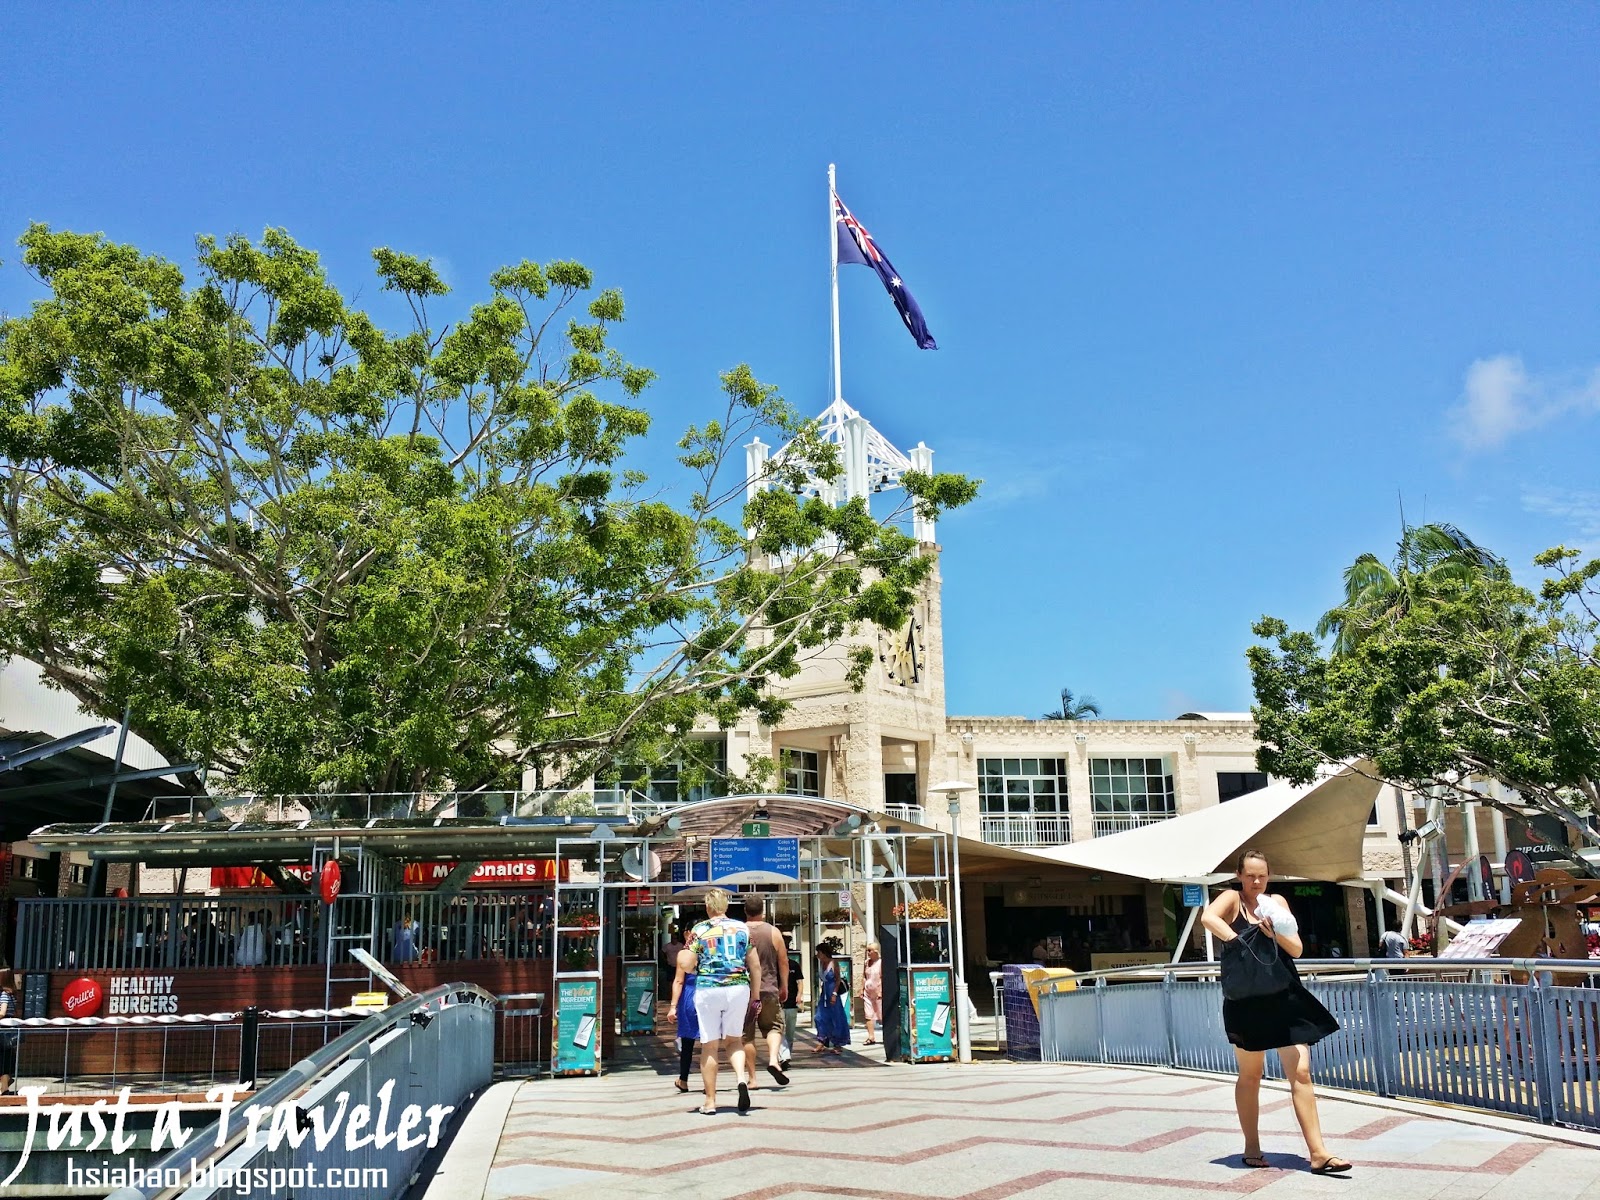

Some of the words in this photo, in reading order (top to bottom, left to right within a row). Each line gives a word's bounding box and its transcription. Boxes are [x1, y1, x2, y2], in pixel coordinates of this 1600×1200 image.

[1533, 844, 1557, 854] CUR
[432, 863, 536, 877] Monald's
[110, 976, 175, 995] HEALTHY
[65, 987, 95, 1011] Grill'd
[109, 995, 179, 1014] BURGERS
